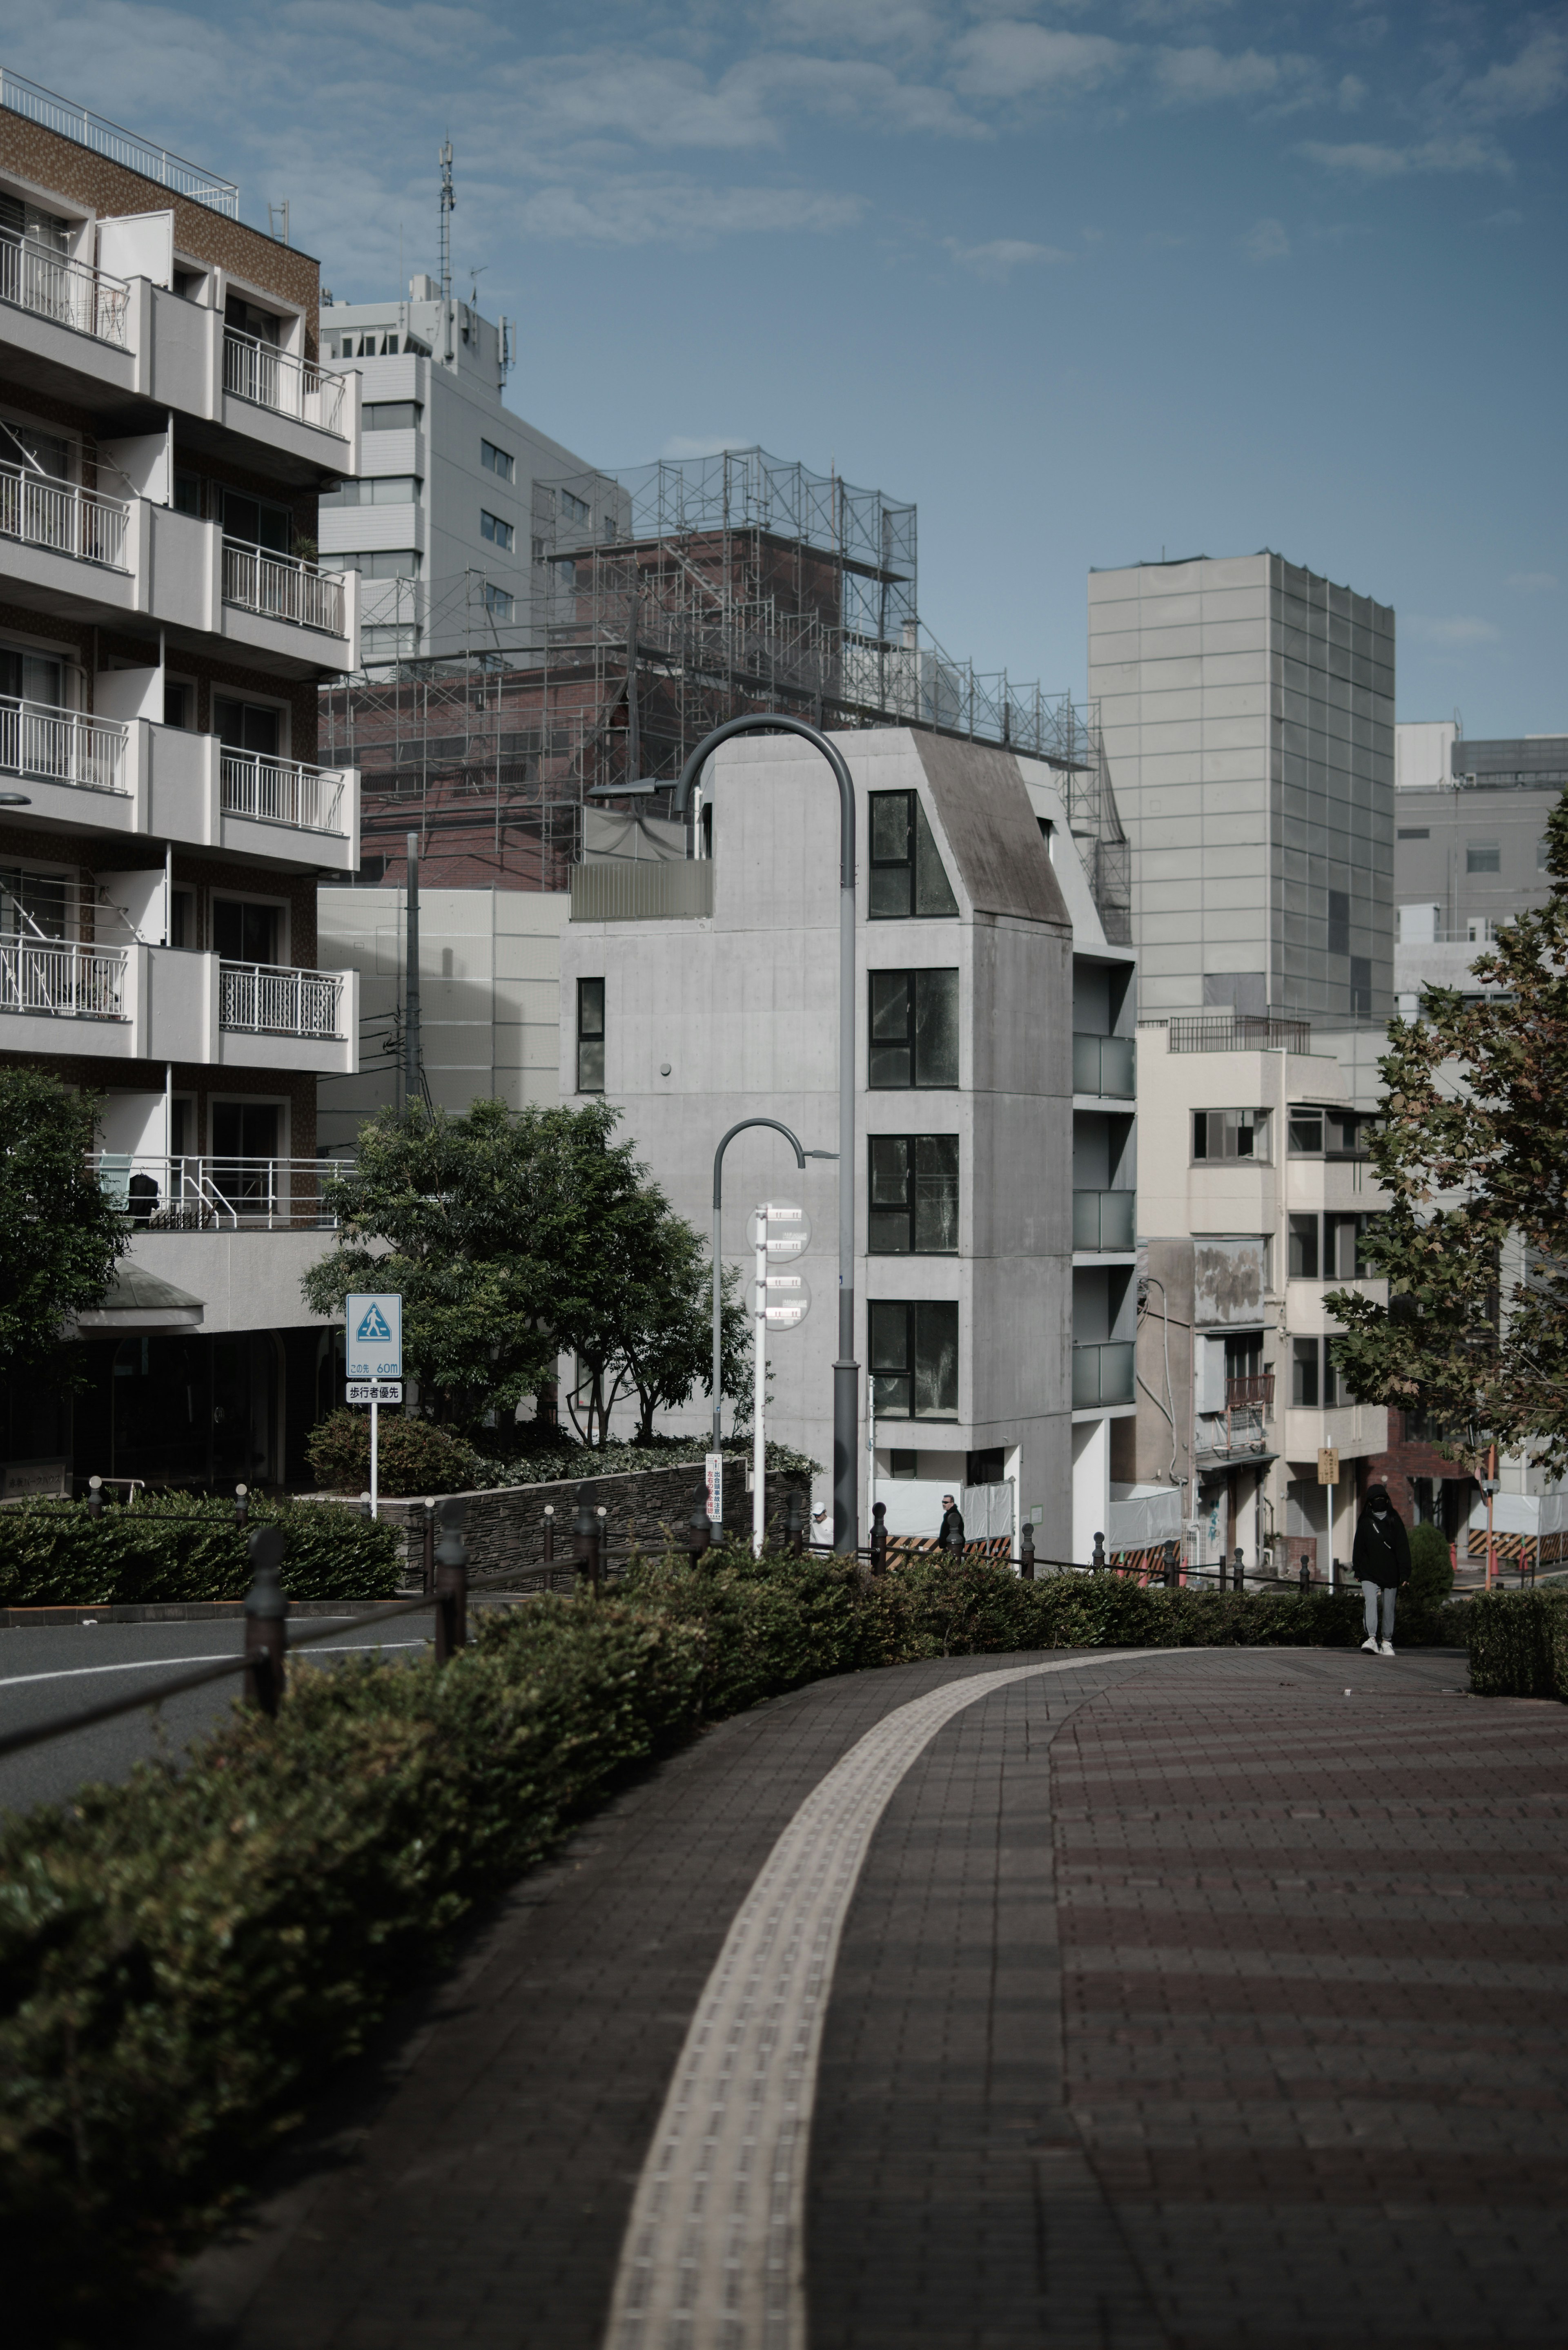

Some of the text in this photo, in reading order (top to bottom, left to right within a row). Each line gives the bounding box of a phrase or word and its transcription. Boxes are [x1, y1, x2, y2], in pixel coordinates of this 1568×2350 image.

[350, 1363, 398, 1373] この先 60m
[350, 1386, 399, 1398] 歩行者優先
